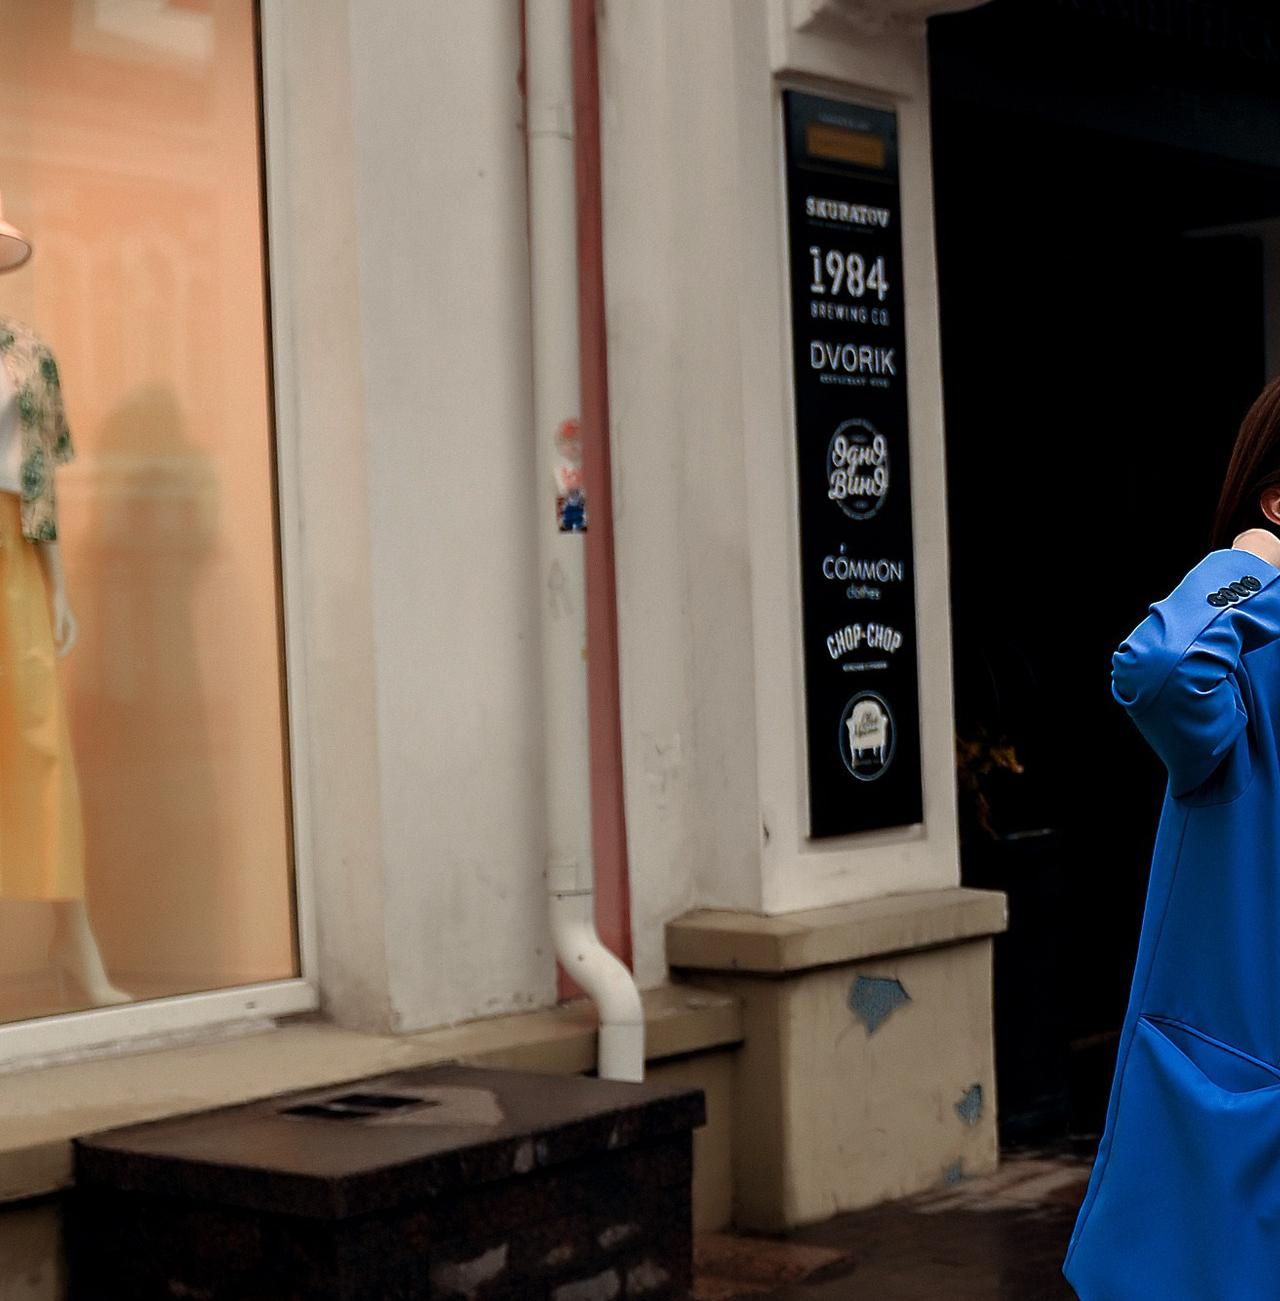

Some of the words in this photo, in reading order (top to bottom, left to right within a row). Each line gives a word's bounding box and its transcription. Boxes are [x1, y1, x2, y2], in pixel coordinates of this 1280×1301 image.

[806, 196, 889, 227] SKURATOV
[809, 245, 889, 300] 1984
[810, 300, 868, 324] BREWING
[810, 339, 896, 376] DVORIK
[826, 621, 904, 660] CHOP-CHOP
